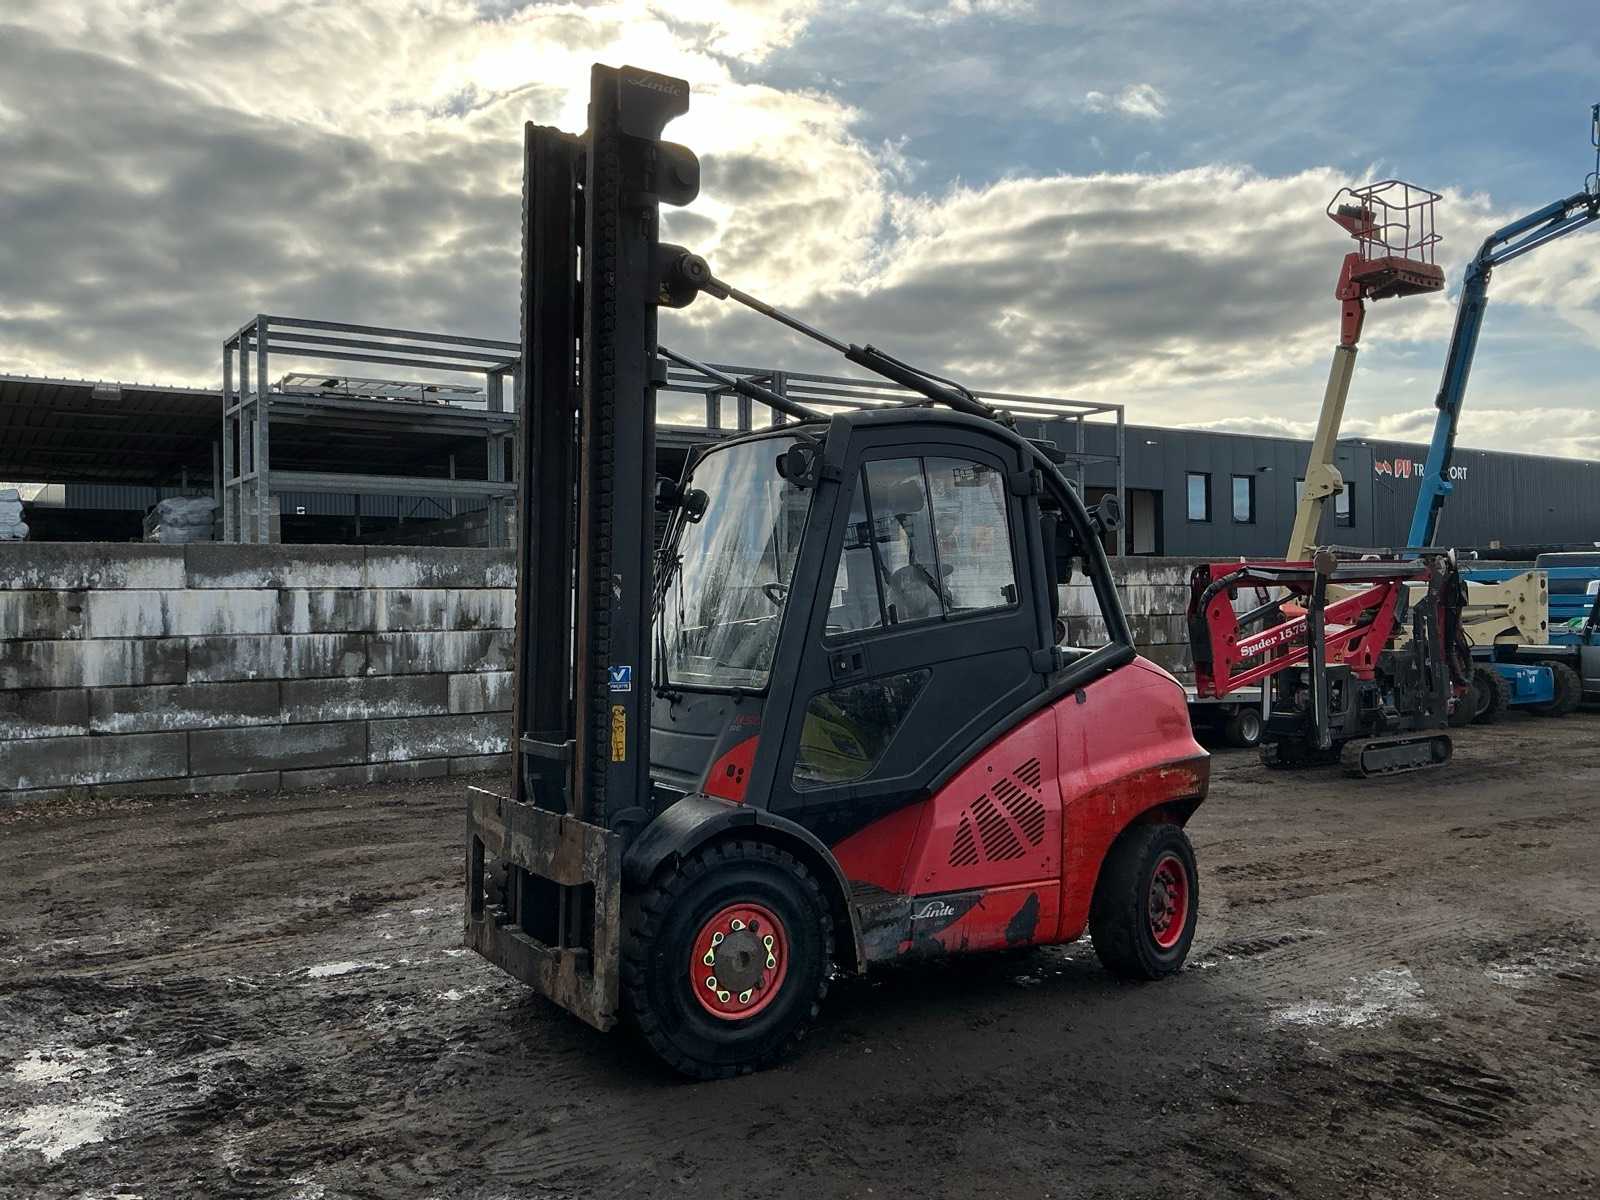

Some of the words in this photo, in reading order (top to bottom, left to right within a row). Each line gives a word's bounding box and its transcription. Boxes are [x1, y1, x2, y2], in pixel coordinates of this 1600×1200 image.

[625, 75, 681, 96] Linde
[1413, 463, 1468, 480] TRORT
[1240, 636, 1277, 657] Spider
[910, 901, 955, 920] Linde
